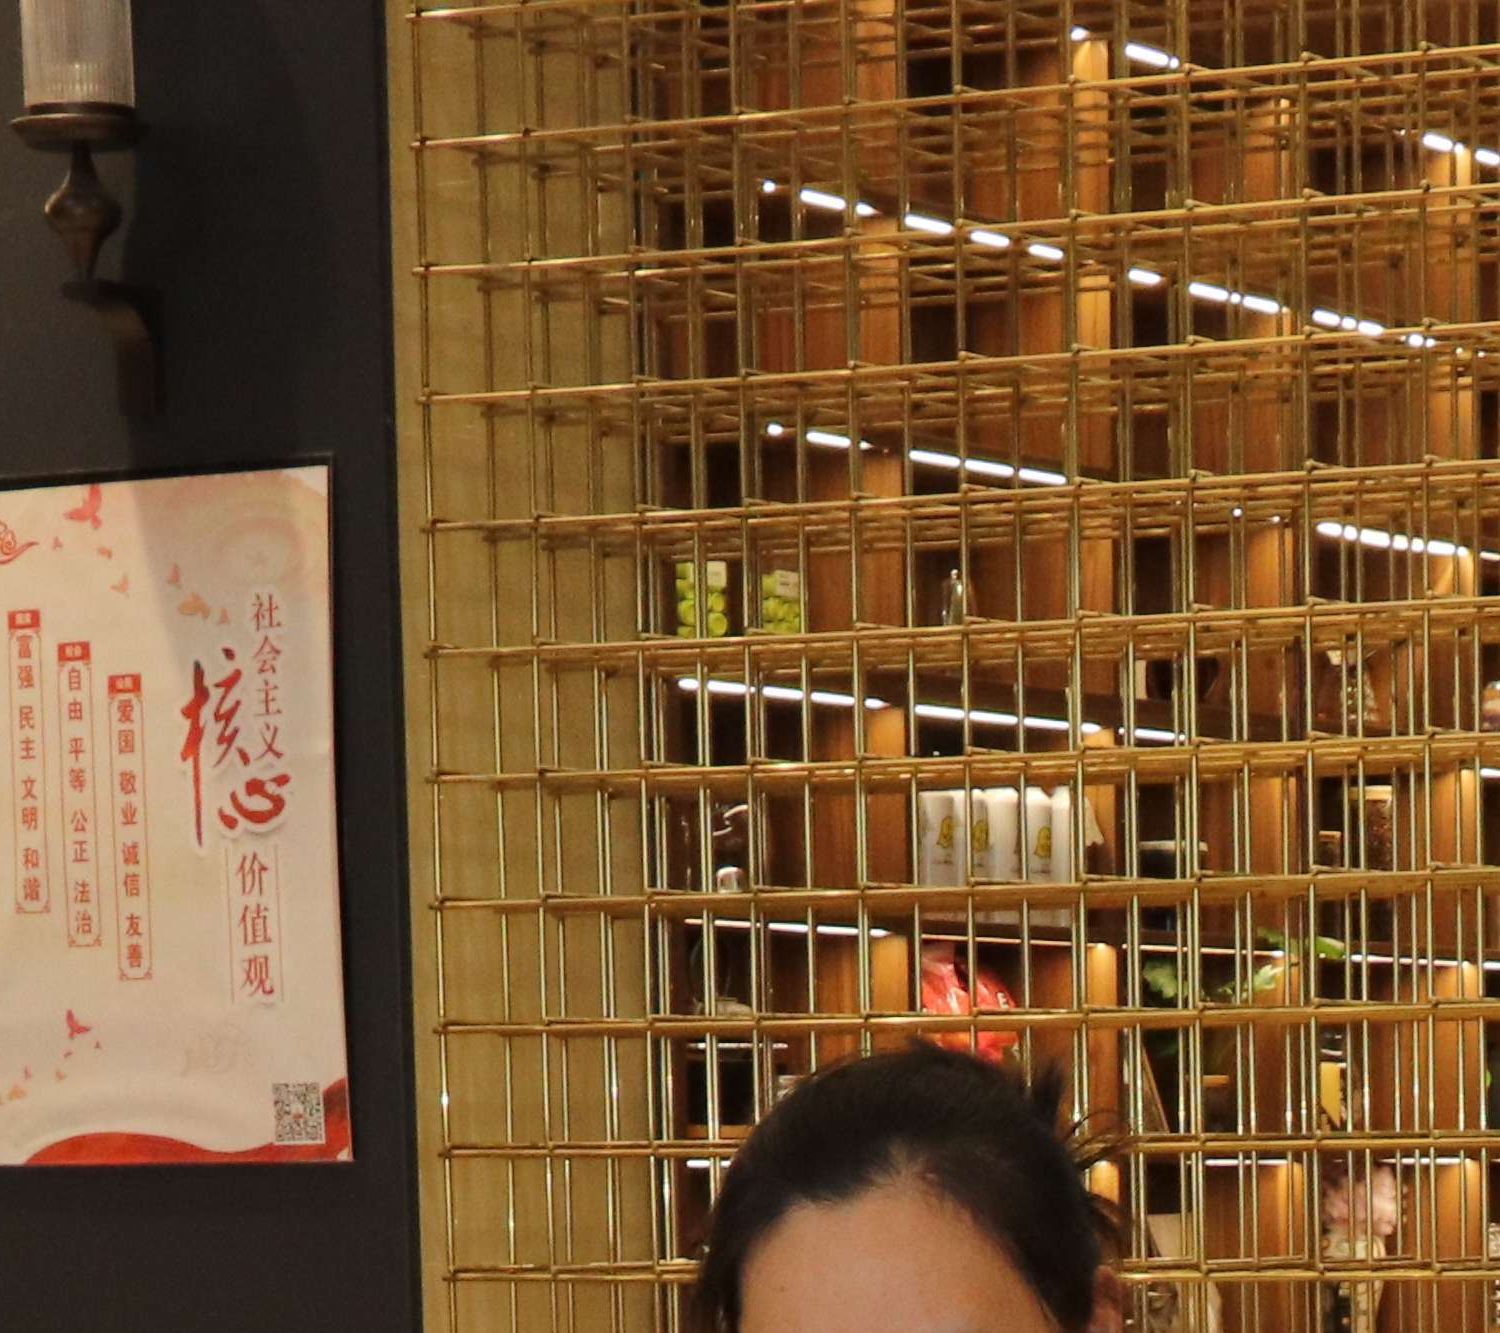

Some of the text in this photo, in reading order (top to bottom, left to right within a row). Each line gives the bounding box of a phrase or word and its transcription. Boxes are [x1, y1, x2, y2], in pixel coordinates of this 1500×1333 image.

[16, 634, 35, 690] 富强
[251, 592, 286, 762] 社会主义
[19, 705, 37, 761] 民主
[116, 698, 136, 755] 爱国
[180, 647, 292, 848] 核心
[21, 775, 39, 831] 文明
[68, 667, 94, 936] 自由 平等 公正 法治
[119, 769, 138, 826] 敬业
[22, 847, 41, 902] 和谐
[121, 842, 141, 898] 诚信
[124, 913, 145, 969] 友善
[236, 850, 275, 998] 价值观
